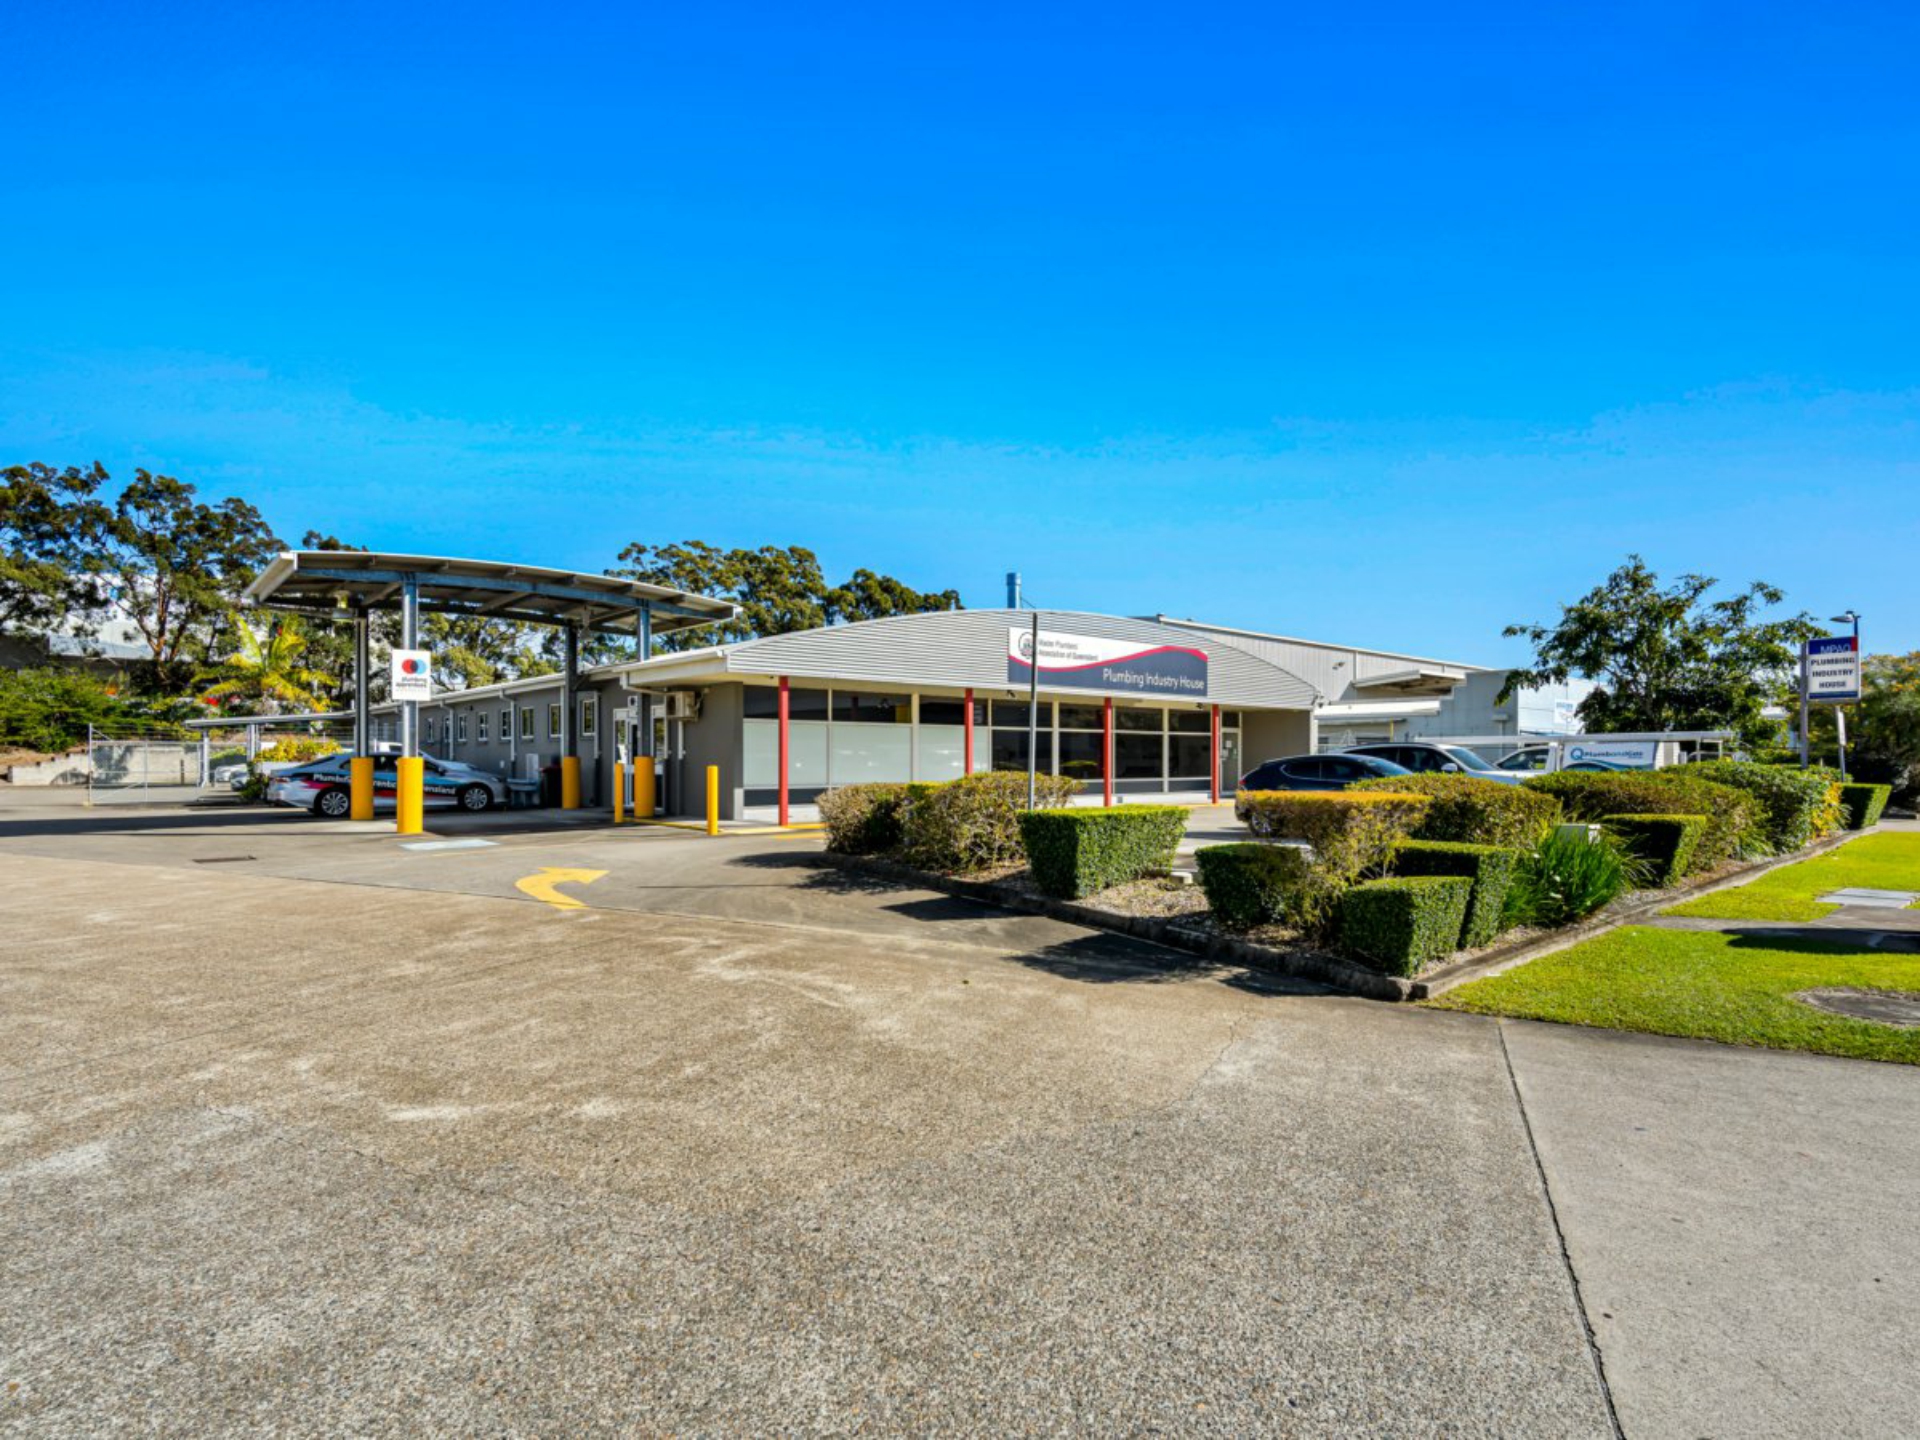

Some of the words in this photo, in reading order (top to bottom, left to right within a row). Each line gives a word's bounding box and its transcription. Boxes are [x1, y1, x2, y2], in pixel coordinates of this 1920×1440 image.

[1811, 657, 1855, 666] PLUMBING
[1812, 669, 1853, 677] INDUSTRY
[1103, 668, 1144, 688] Plumbing
[1146, 672, 1178, 690] Industry
[1180, 675, 1205, 690] House
